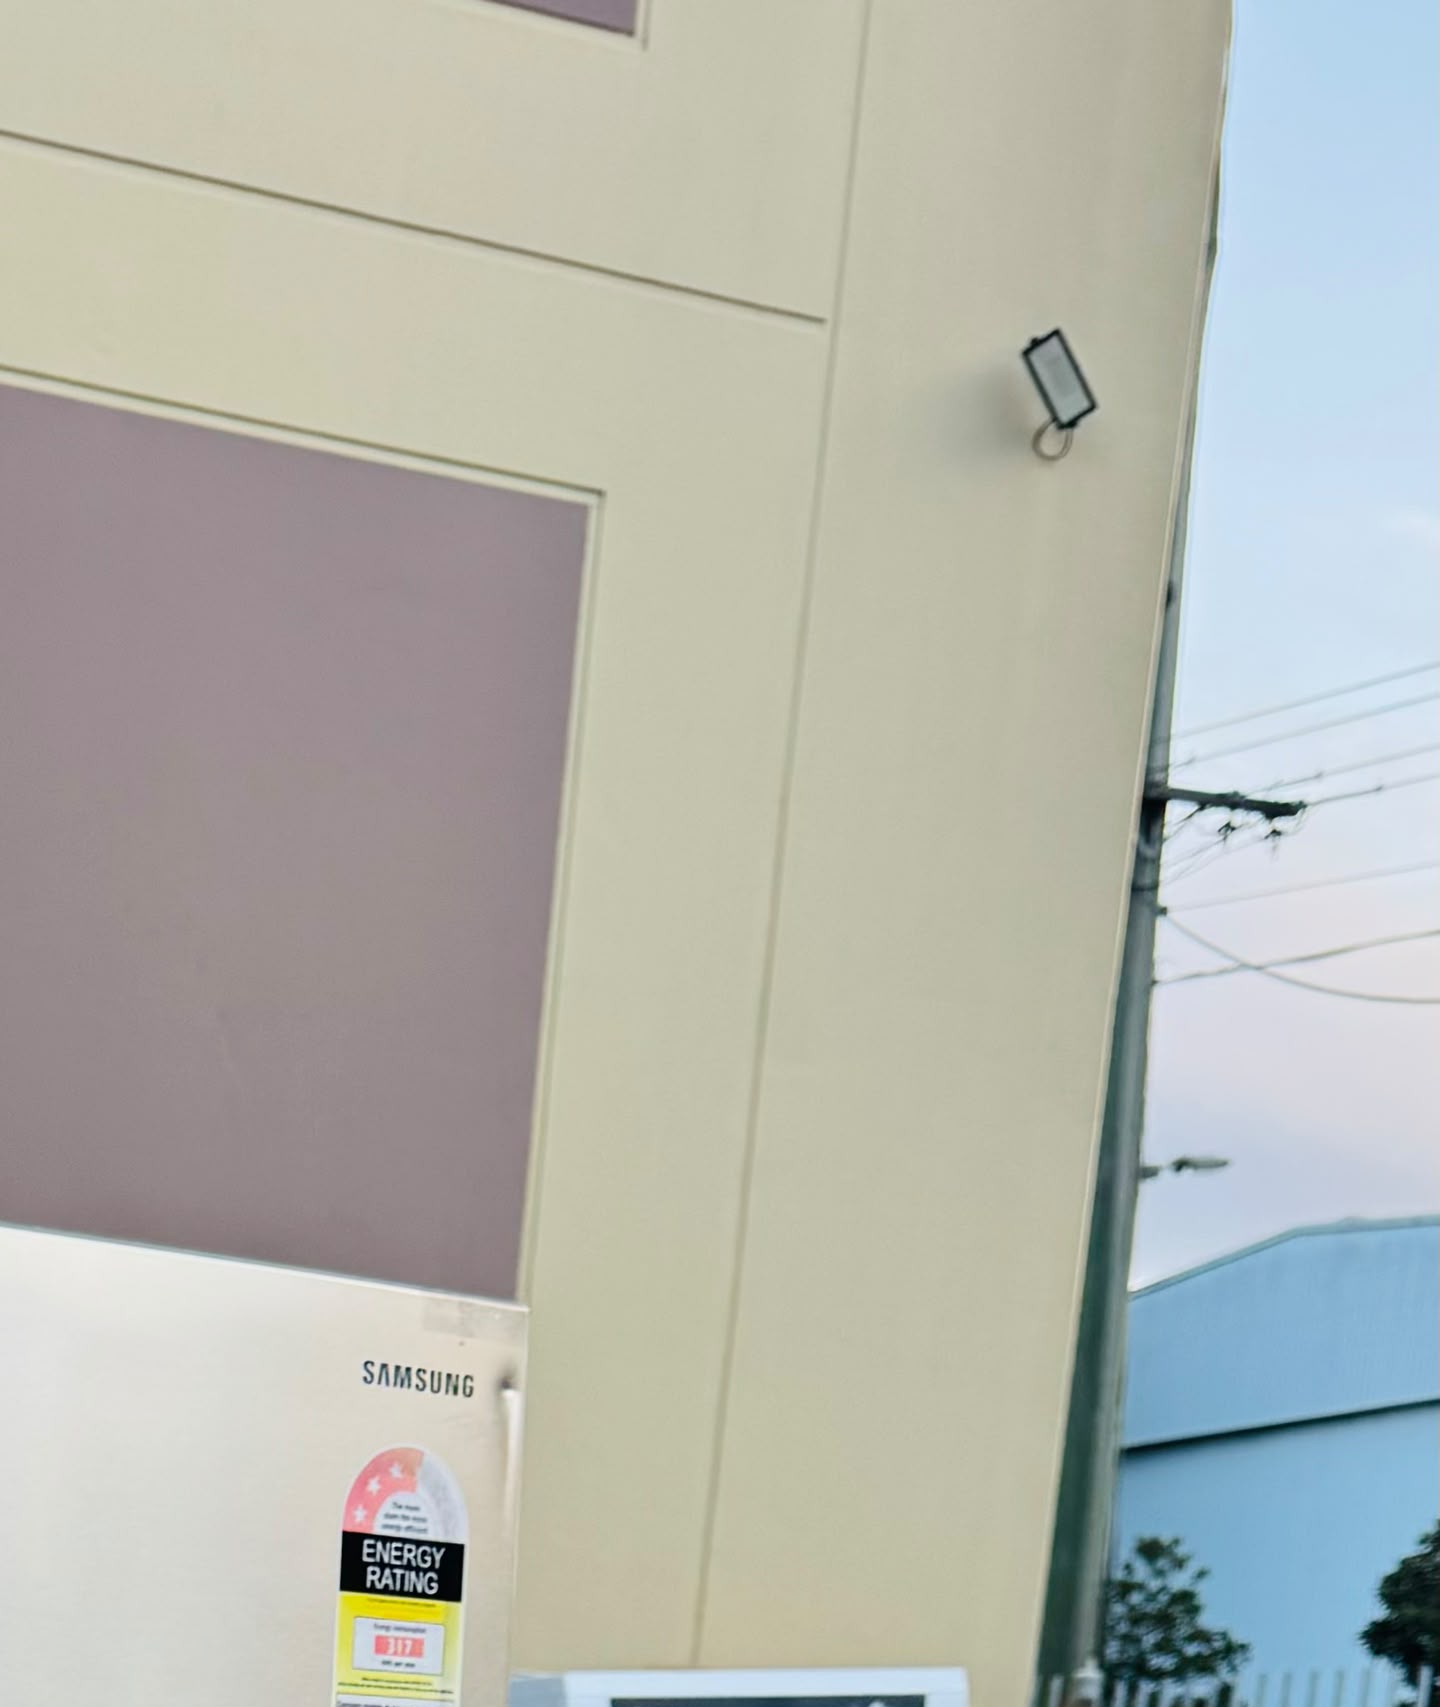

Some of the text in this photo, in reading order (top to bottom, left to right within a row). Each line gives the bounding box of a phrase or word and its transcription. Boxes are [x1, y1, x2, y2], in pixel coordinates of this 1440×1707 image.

[362, 1360, 475, 1398] SAMSUNG
[361, 1538, 446, 1569] ENERGY
[365, 1565, 439, 1595] RATING
